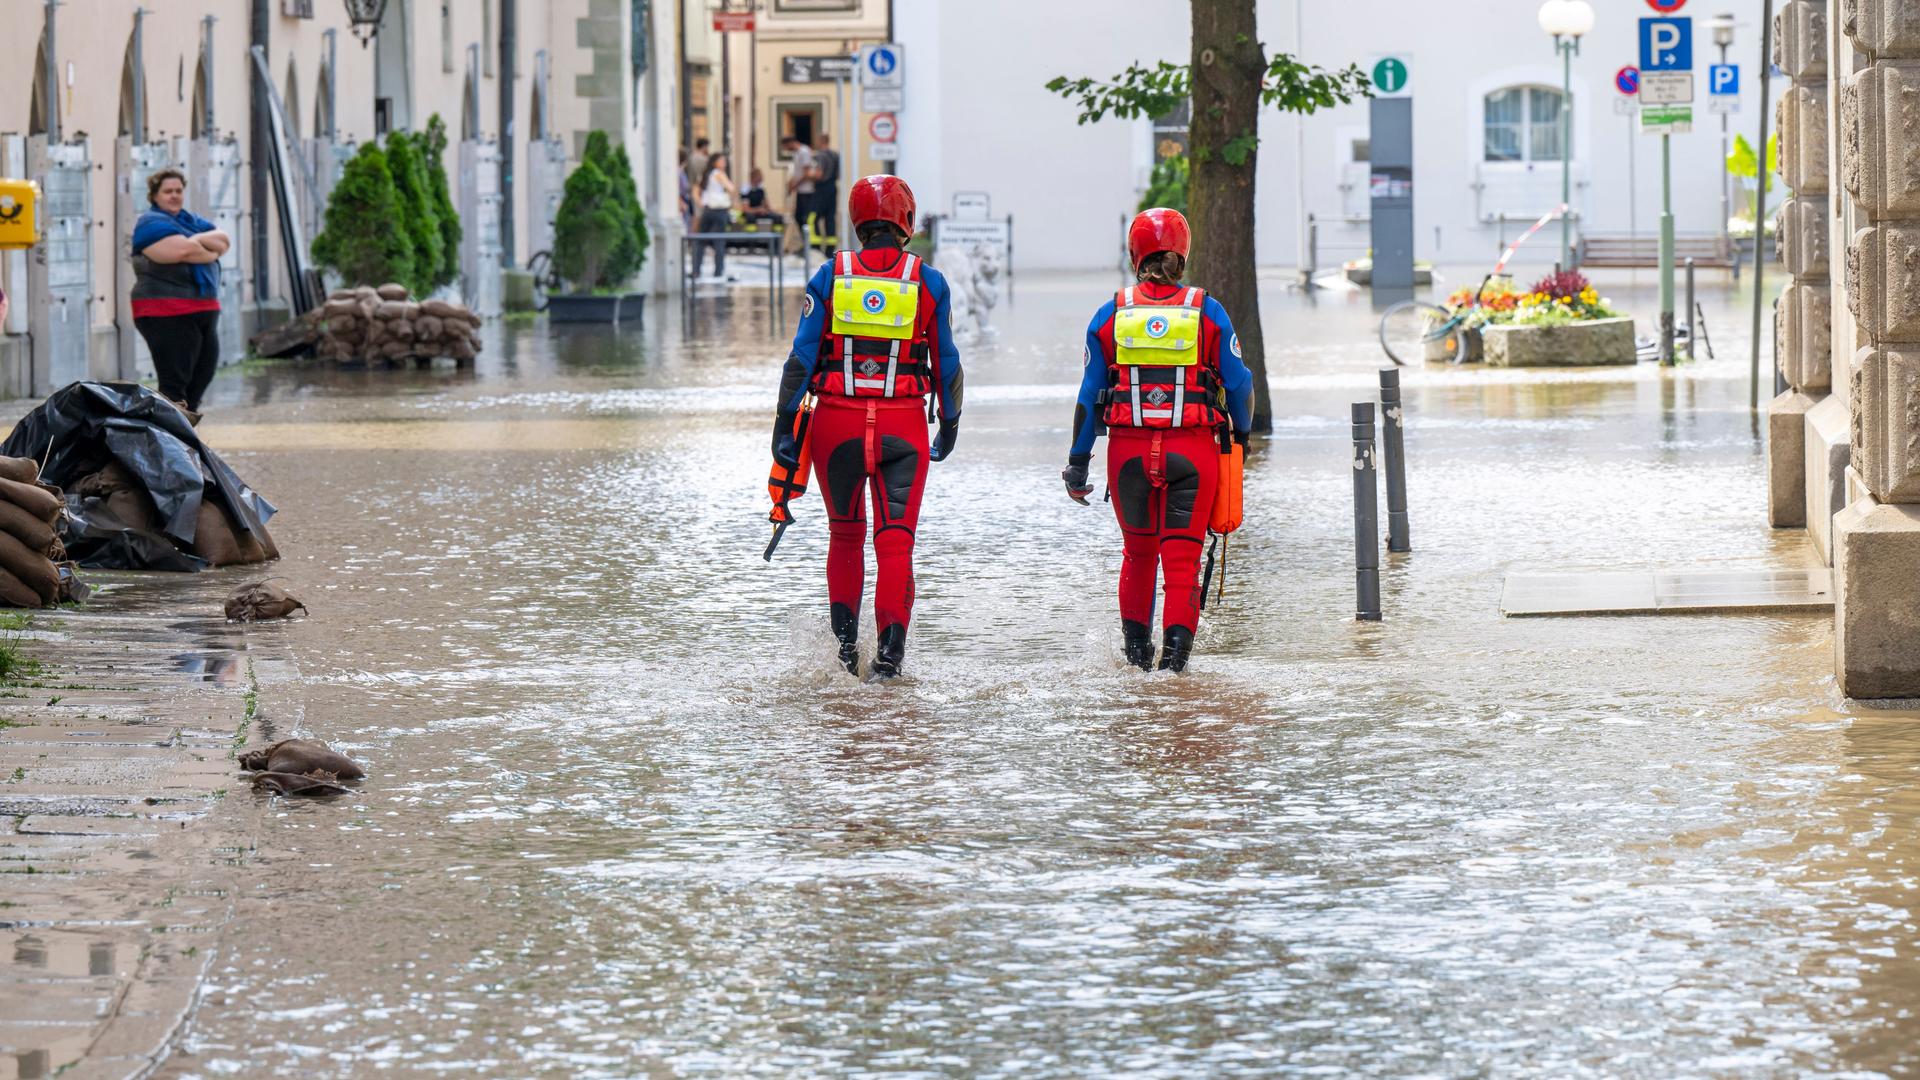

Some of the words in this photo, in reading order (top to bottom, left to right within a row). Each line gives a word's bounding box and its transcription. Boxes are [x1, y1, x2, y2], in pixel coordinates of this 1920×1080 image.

[1650, 22, 1681, 66] P
[1384, 59, 1396, 91] i
[1715, 66, 1734, 94] P
